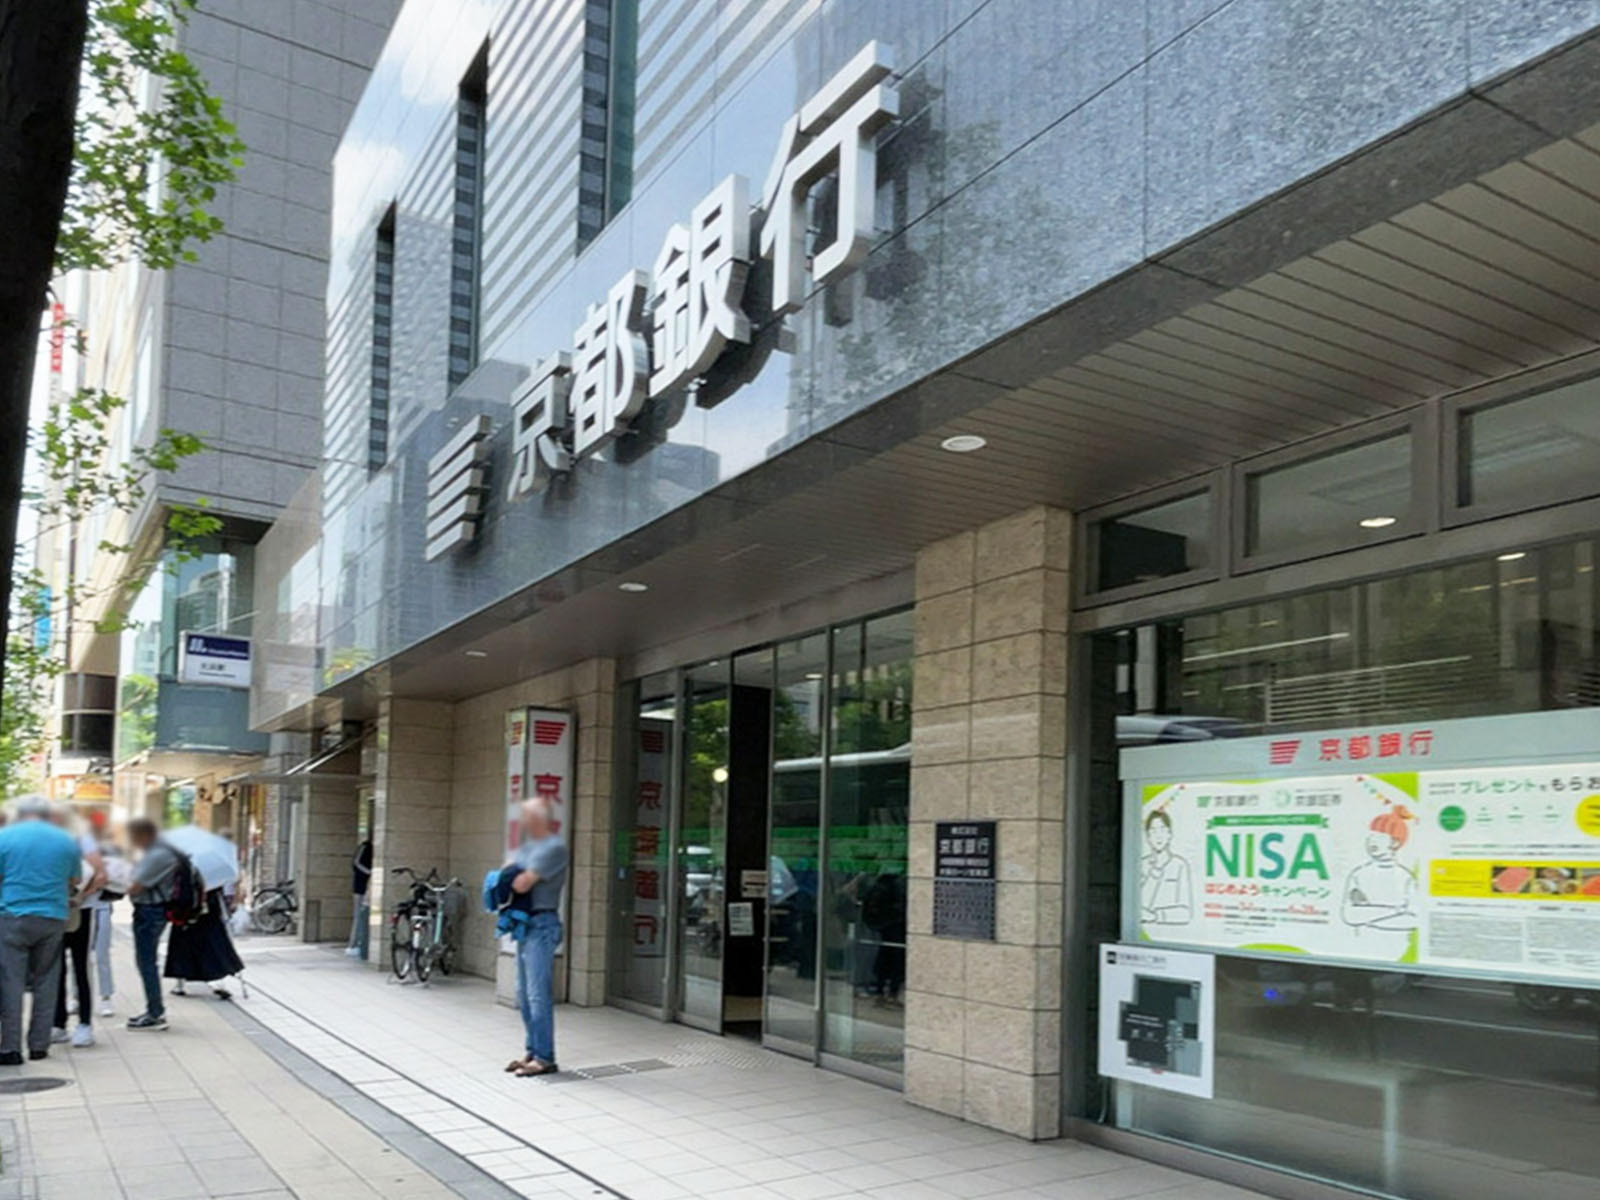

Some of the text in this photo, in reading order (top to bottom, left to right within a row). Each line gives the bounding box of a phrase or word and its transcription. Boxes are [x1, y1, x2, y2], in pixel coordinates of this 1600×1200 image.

[507, 40, 900, 501] 京都銀行
[1318, 729, 1434, 762] 京都銀行
[1205, 832, 1330, 880] NISA
